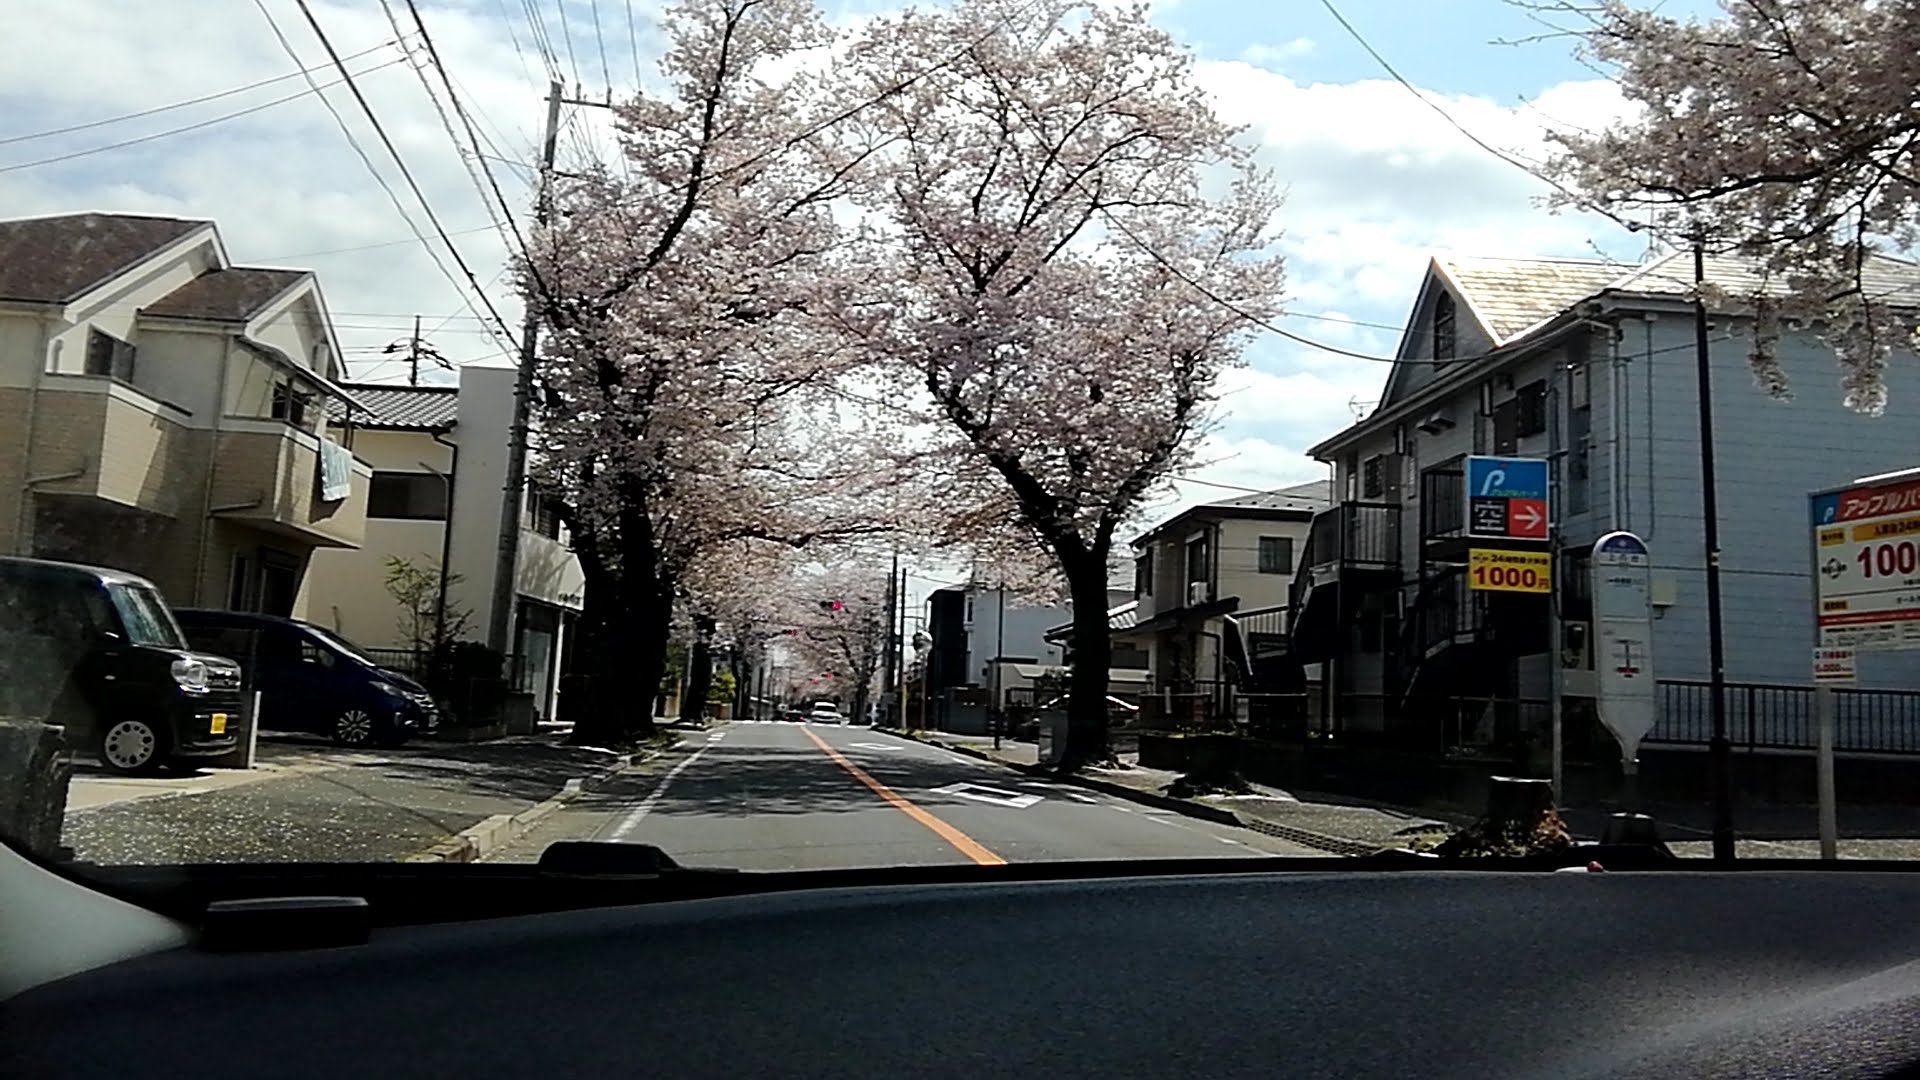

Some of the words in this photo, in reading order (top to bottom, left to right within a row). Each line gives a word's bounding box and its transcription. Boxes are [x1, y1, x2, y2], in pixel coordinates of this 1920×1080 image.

[1474, 500, 1505, 531] 空
[1844, 489, 1920, 518] アップルパ
[1857, 541, 1920, 578] 100
